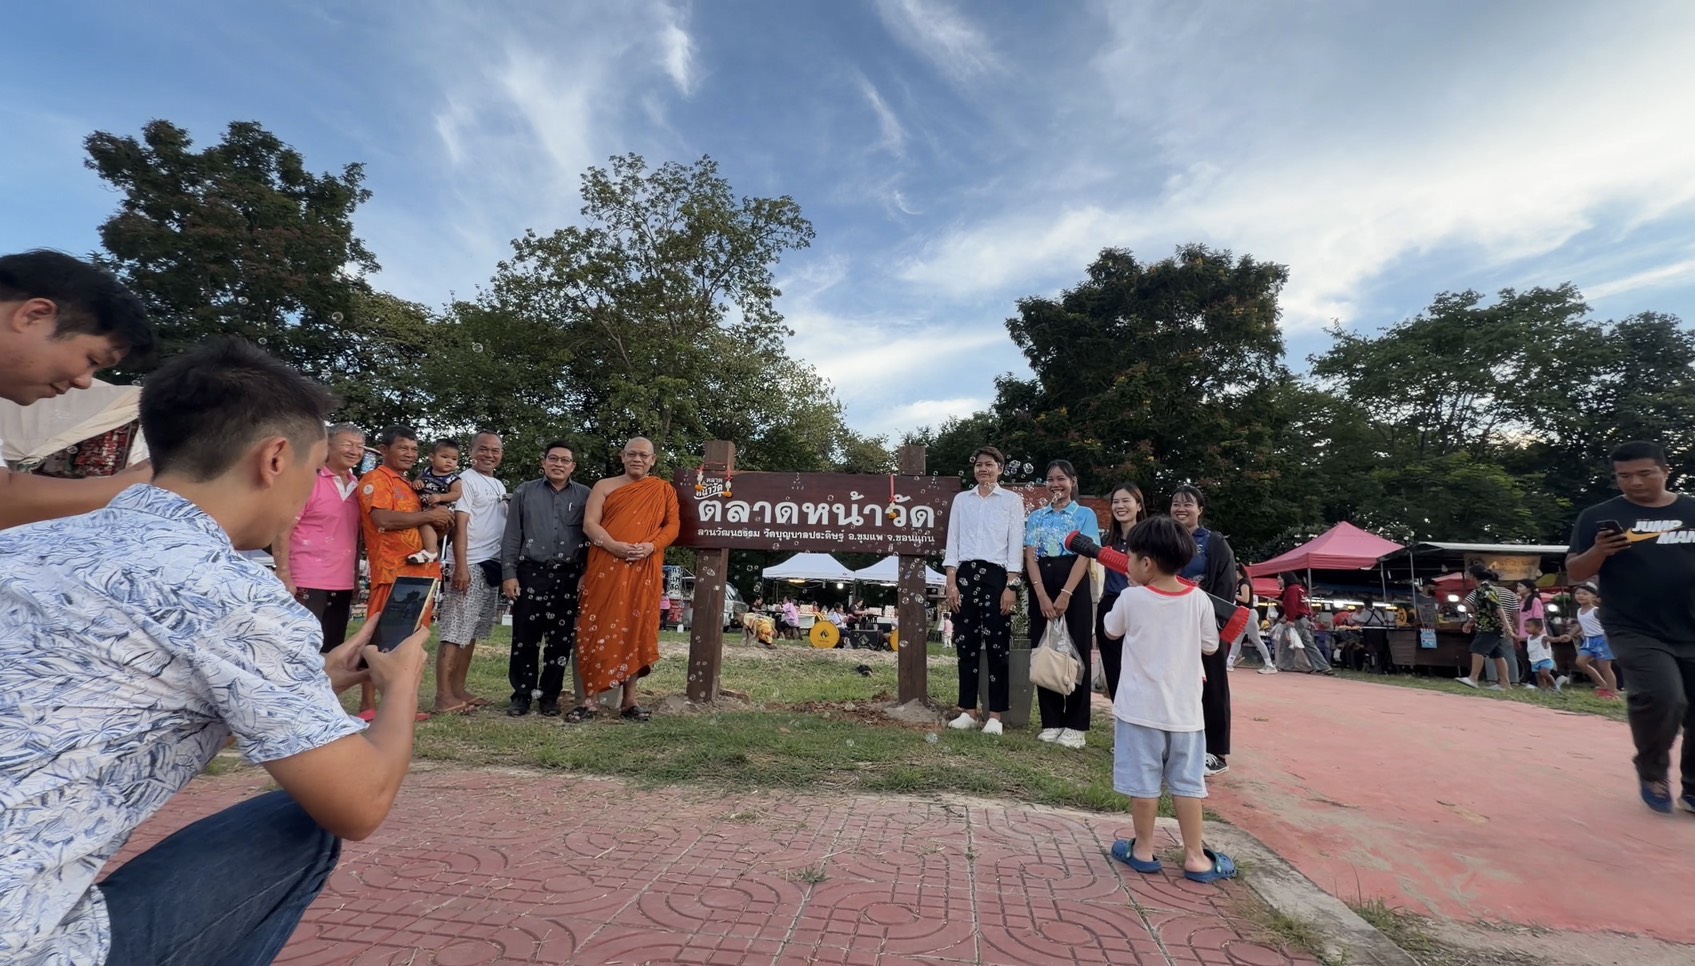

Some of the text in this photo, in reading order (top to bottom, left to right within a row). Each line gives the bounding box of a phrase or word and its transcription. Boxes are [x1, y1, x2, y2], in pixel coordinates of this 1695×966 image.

[698, 491, 935, 528] ตลาดหน้าวัด
[1632, 520, 1683, 532] JUMP
[697, 527, 760, 538] ลานวัฒนธรรม
[848, 533, 883, 543] อ.ชุมแพ
